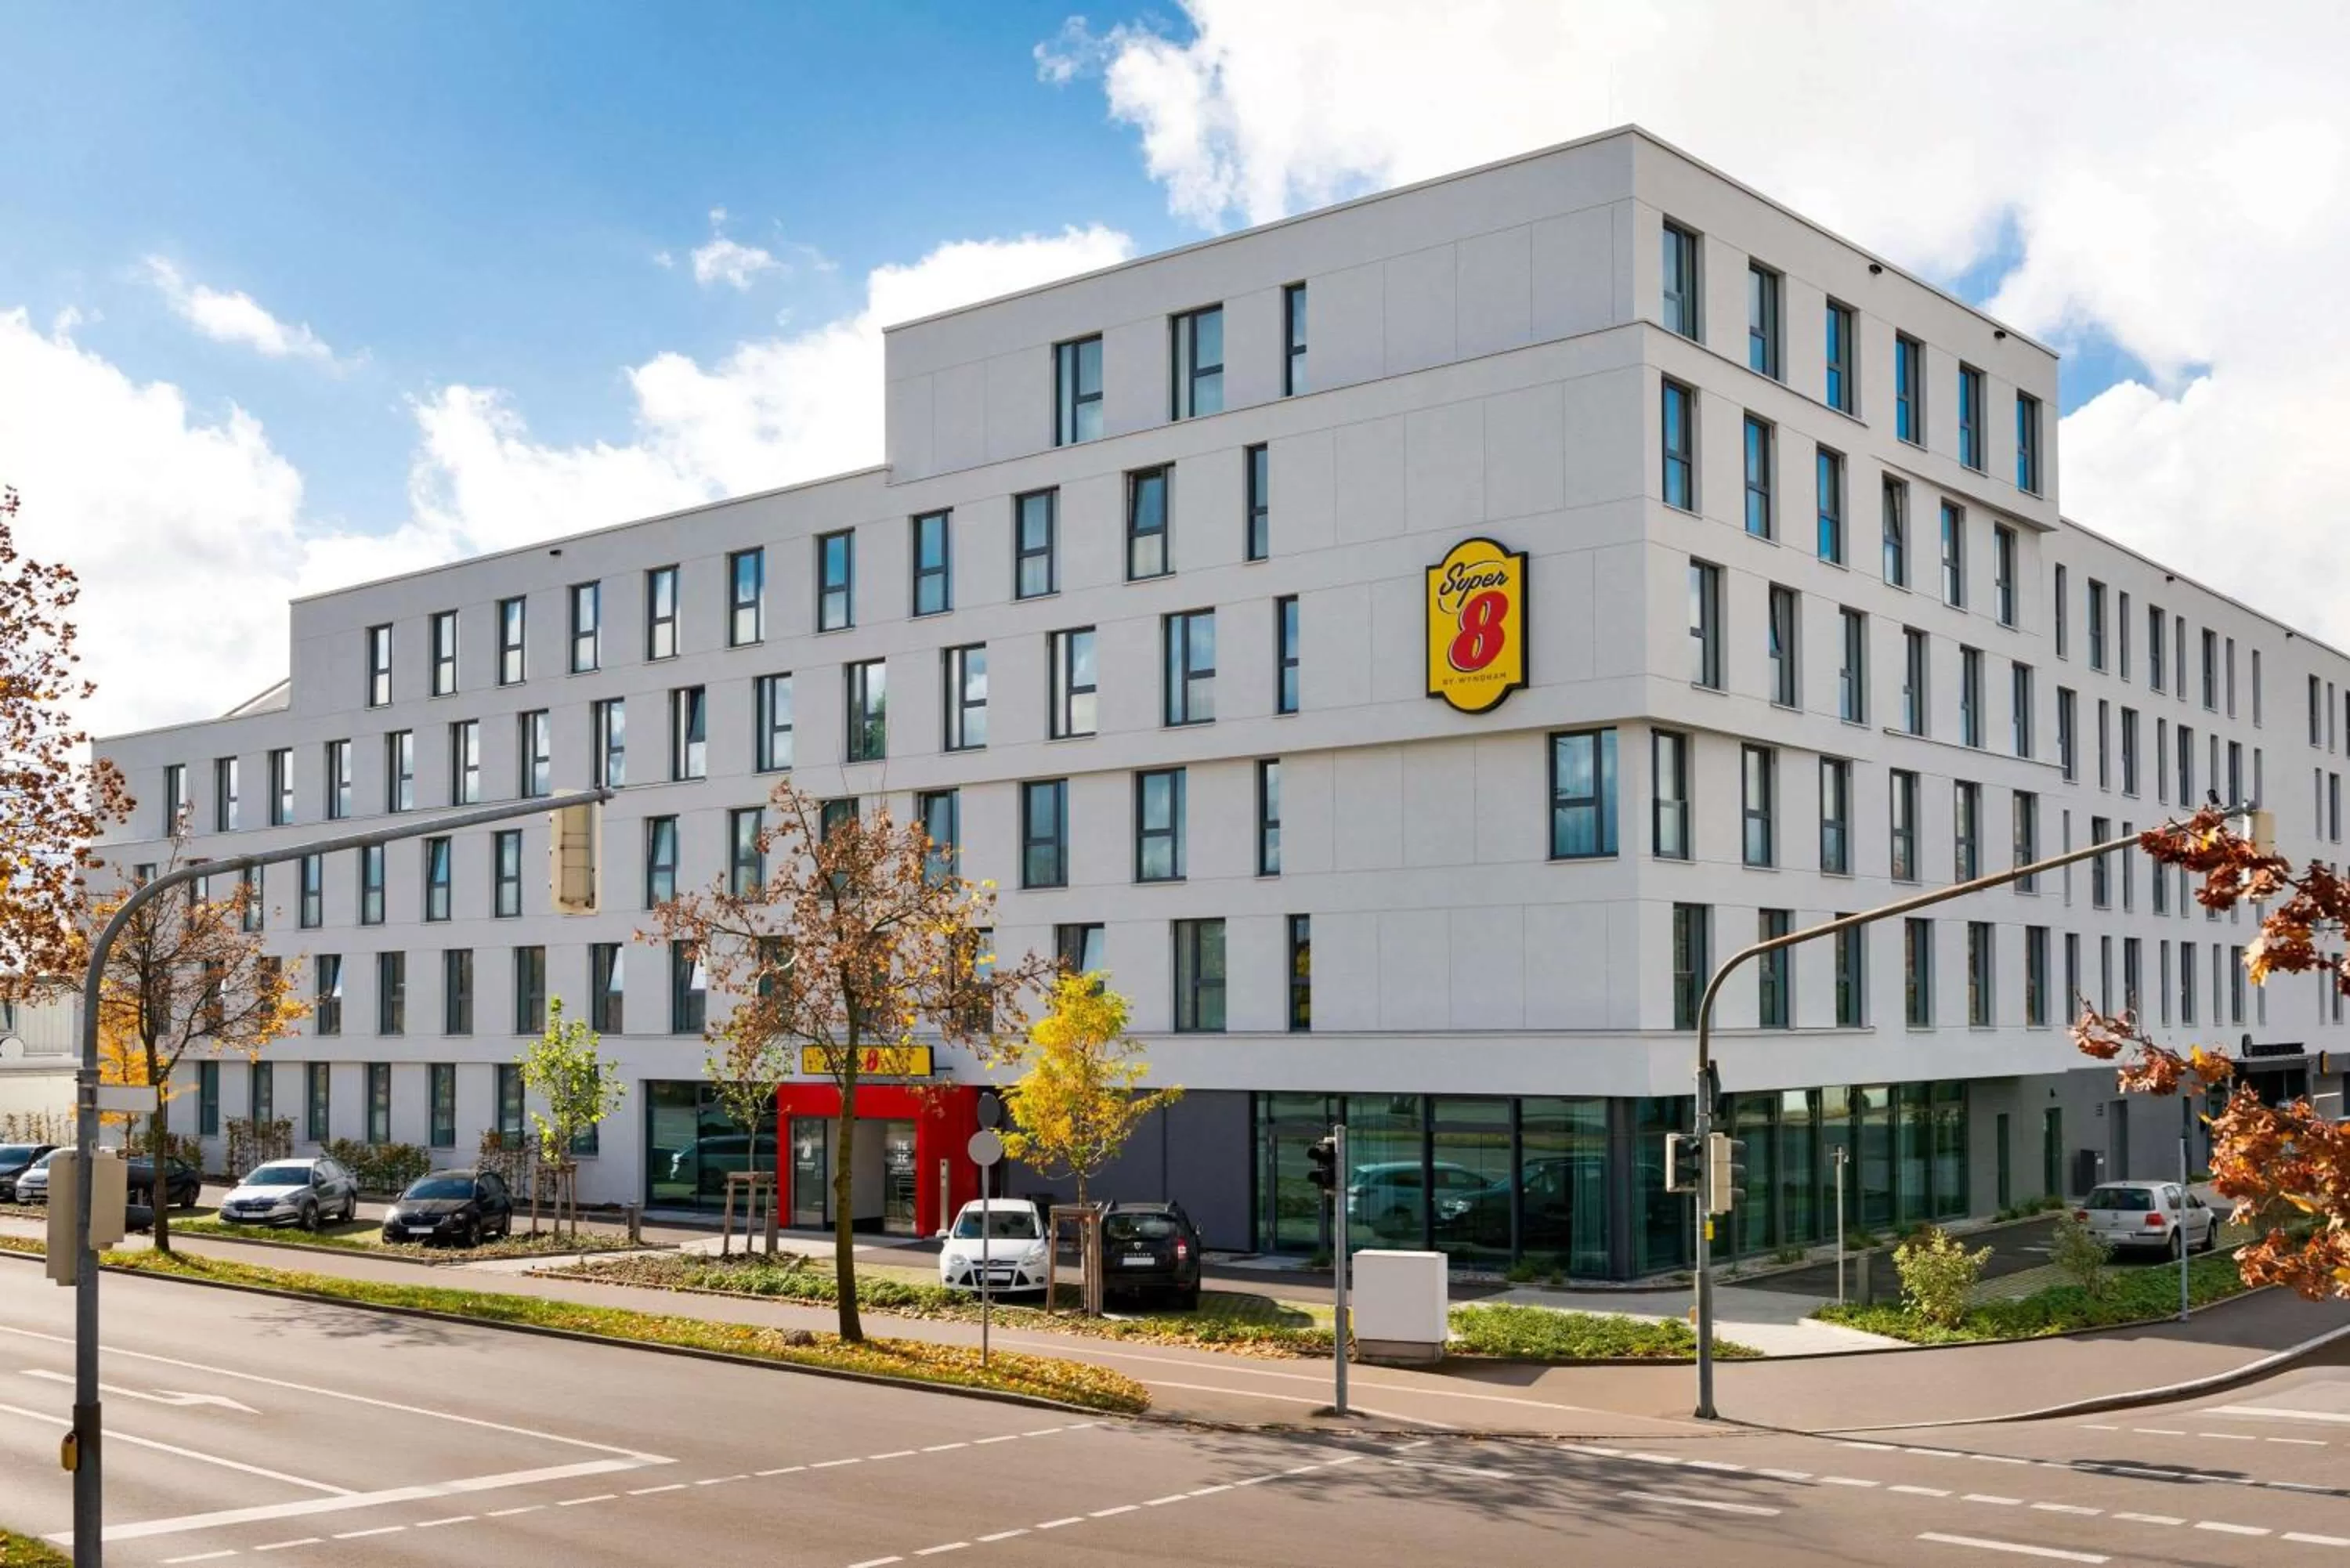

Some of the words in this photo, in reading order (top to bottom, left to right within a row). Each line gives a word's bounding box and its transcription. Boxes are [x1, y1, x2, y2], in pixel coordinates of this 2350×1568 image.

[1438, 560, 1509, 610] Super
[1448, 591, 1509, 672] 8
[1459, 672, 1507, 684] WYNDHAM
